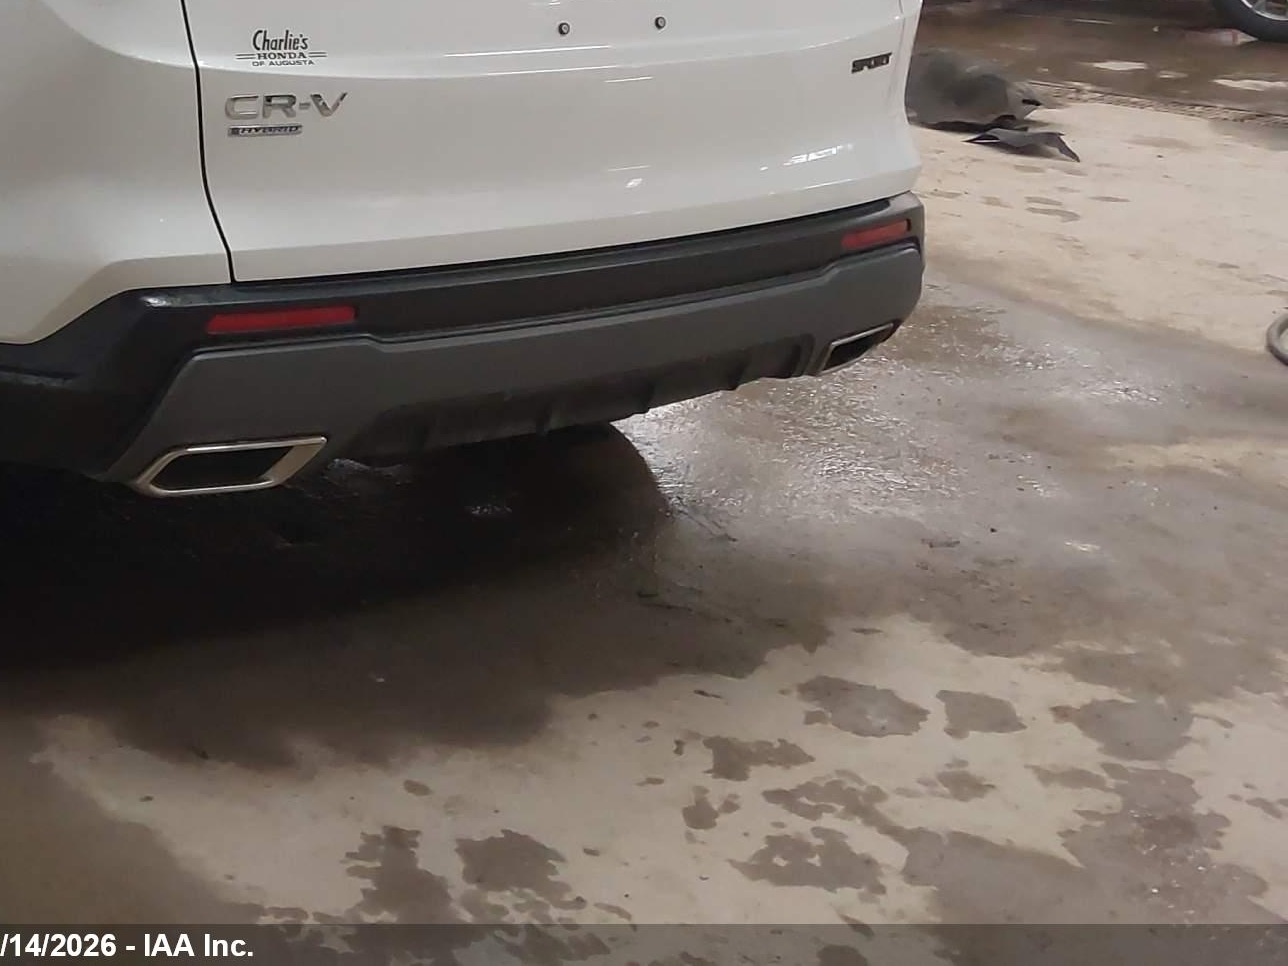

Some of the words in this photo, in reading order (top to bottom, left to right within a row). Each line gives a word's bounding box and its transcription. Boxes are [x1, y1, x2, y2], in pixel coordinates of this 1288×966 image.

[252, 30, 309, 51] Charlie's
[257, 52, 307, 60] HONDA
[225, 92, 348, 120] CR-V
